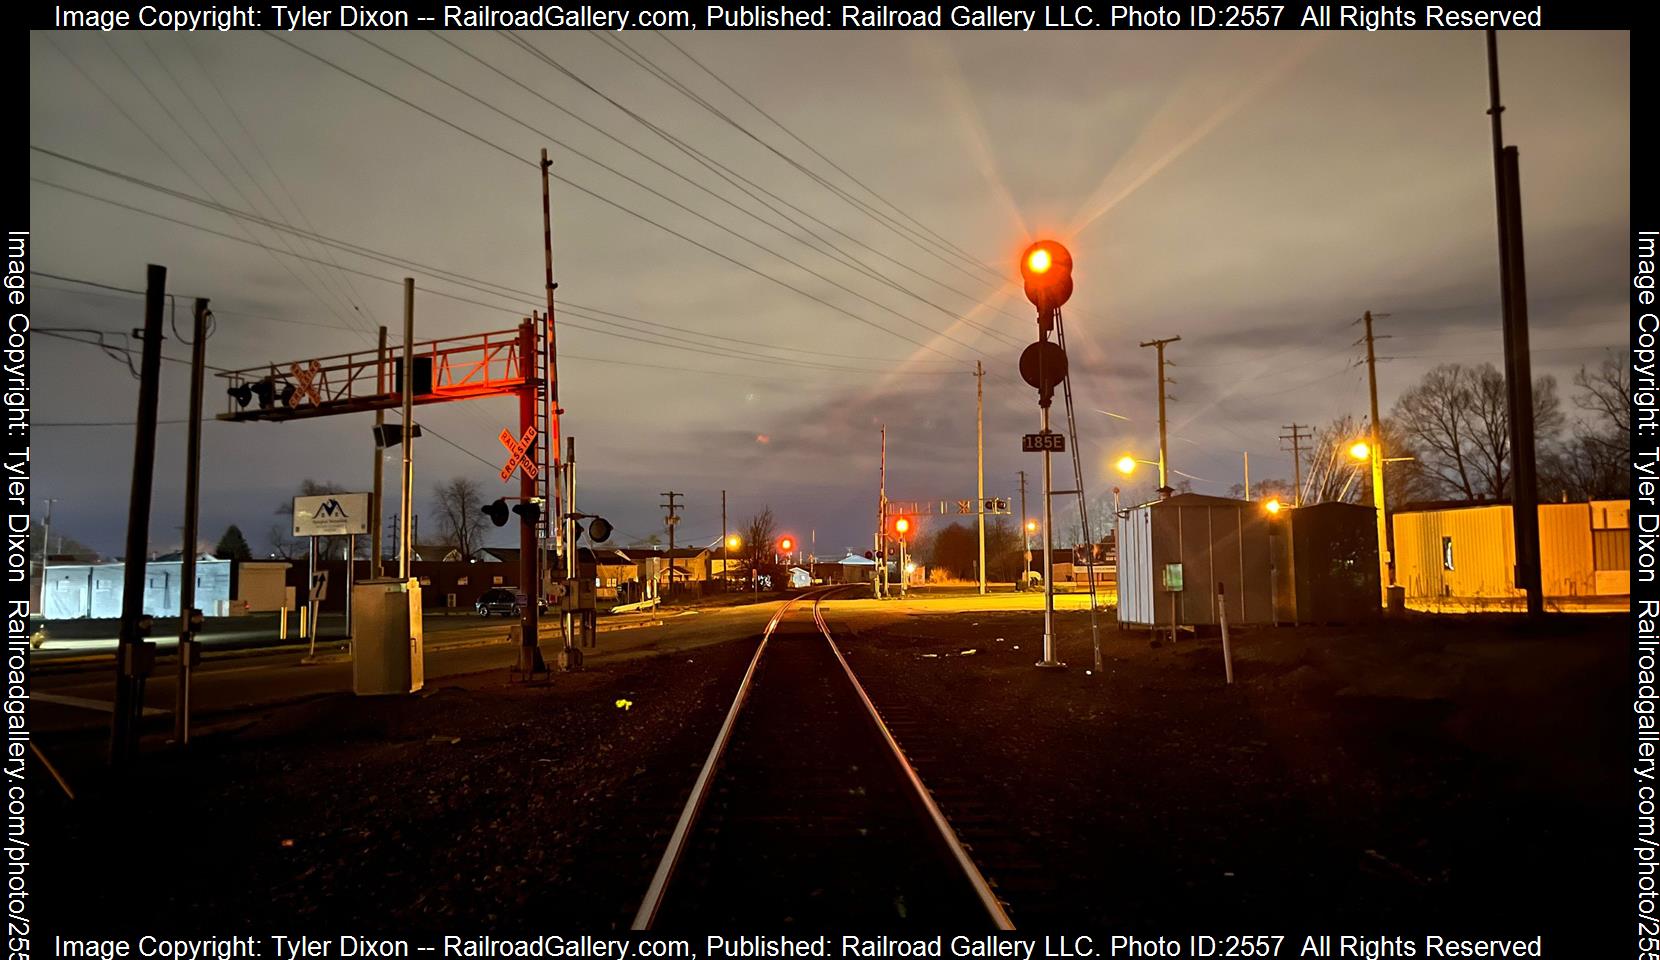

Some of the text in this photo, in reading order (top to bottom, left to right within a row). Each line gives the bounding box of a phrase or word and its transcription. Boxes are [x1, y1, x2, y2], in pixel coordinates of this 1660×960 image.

[501, 432, 516, 453] RAIL
[1026, 436, 1062, 448] 185E
[501, 428, 534, 479] CROSSING
